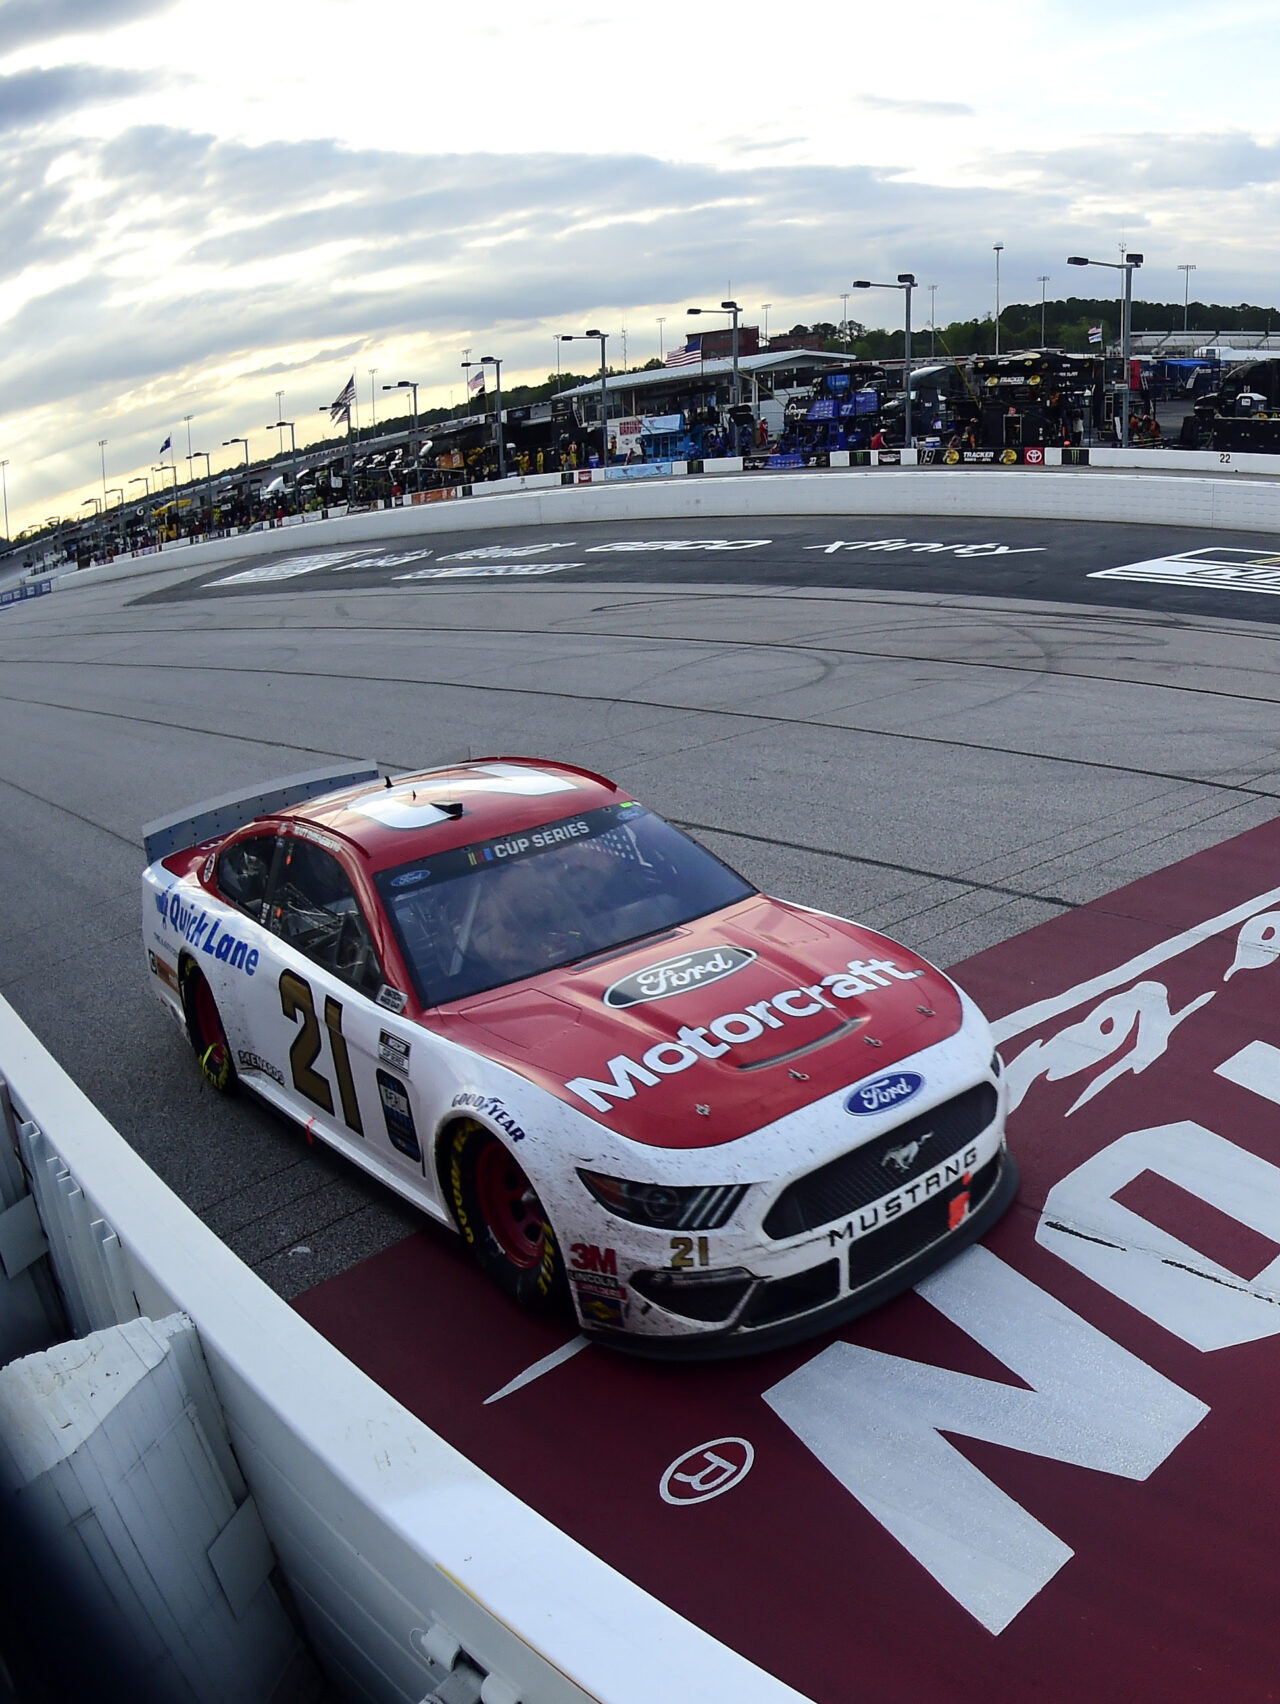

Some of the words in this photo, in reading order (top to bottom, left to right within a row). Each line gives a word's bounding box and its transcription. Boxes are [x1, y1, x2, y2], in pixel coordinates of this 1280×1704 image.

[920, 449, 936, 465] 19
[963, 451, 994, 459] TRACKER
[1219, 453, 1231, 464] 22
[493, 837, 531, 859] CUP
[533, 820, 591, 849] SERIES
[169, 893, 209, 949] Quick
[201, 917, 260, 977] Lane
[636, 951, 735, 996] Ford
[277, 967, 366, 1139] 21
[563, 956, 918, 1114] Motorcraft
[860, 1079, 913, 1110] Ford
[828, 1146, 978, 1247] MUSTANG
[570, 1243, 618, 1277] 3M
[669, 1236, 710, 1268] 21
